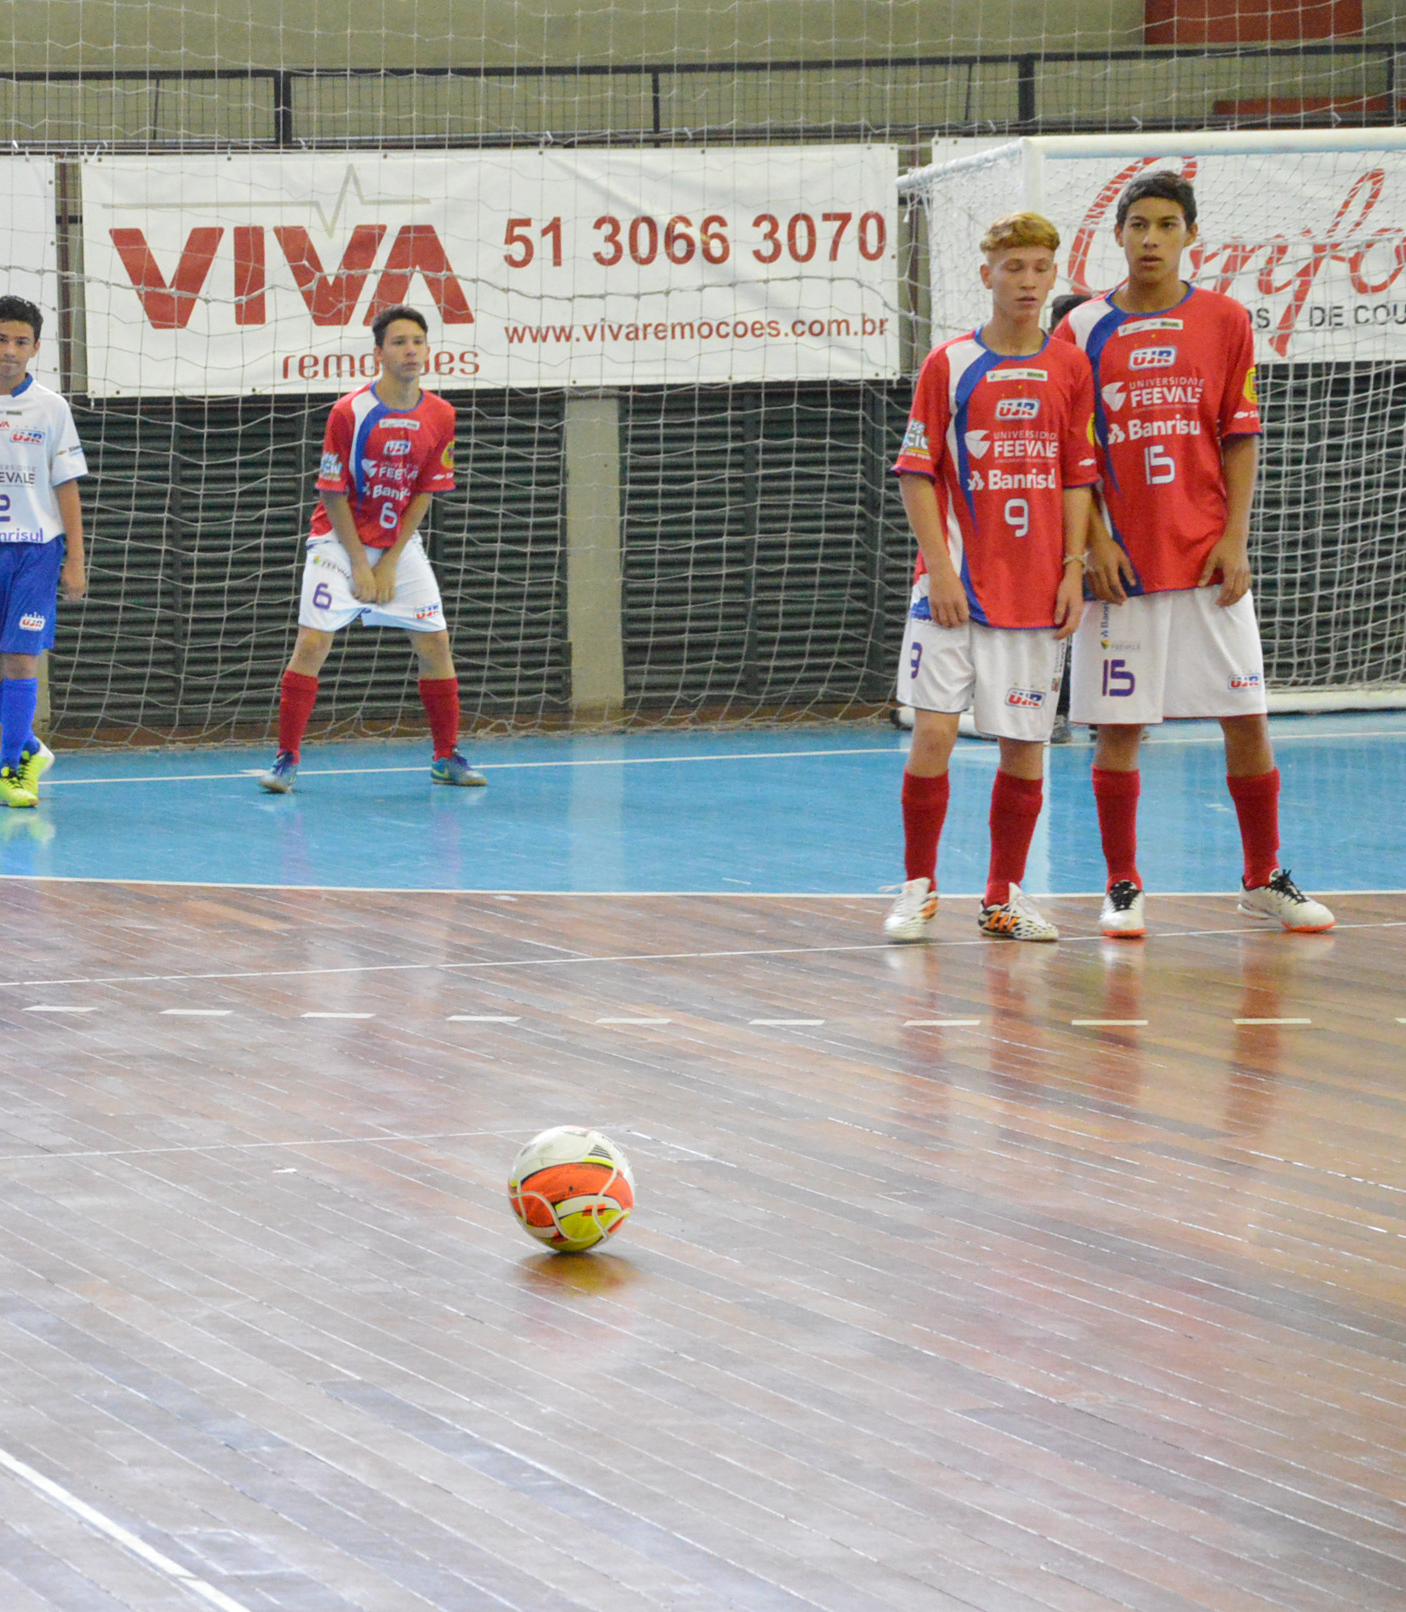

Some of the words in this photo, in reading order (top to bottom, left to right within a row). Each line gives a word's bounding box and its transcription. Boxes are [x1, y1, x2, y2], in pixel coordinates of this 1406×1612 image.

[503, 217, 562, 268] 51
[592, 214, 730, 266] 3066
[752, 211, 886, 263] 3070
[108, 224, 475, 329] VIVA
[504, 313, 889, 343] www.vivaremocoes.com.br
[1309, 306, 1343, 327] DE
[282, 350, 480, 379] remoes
[1132, 349, 1173, 366] UJR
[998, 402, 1036, 417] UJR
[1130, 386, 1203, 408] FEEVALE
[1127, 414, 1201, 441] Banrisu
[994, 440, 1059, 458] FEEVALE
[1144, 444, 1176, 485] 15
[379, 502, 398, 529] 6
[1004, 498, 1030, 537] 9
[312, 582, 332, 610] 6
[1102, 659, 1136, 697] 15
